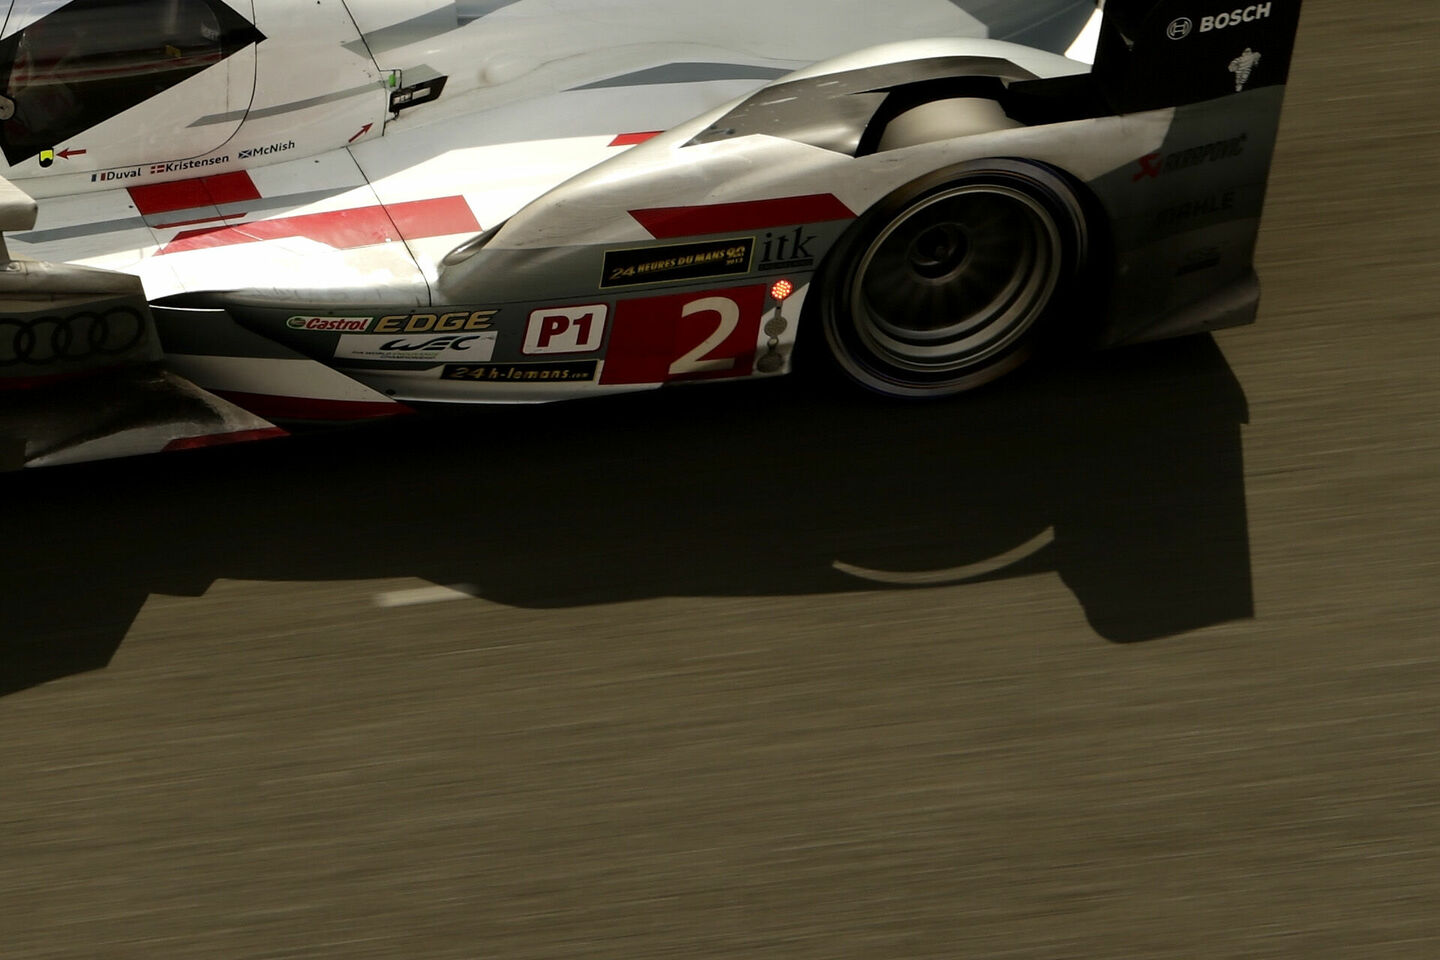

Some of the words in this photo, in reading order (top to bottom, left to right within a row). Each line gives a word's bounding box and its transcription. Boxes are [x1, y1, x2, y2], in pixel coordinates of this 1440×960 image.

[1199, 2, 1272, 33] BOSCH
[106, 167, 142, 181] Duval
[165, 154, 230, 173] Kristensen
[251, 140, 296, 157] McNish
[760, 227, 817, 263] itk
[609, 265, 636, 280] 24
[637, 257, 677, 273] HEURES
[677, 253, 695, 266] DU
[695, 248, 726, 263] MANS
[305, 317, 369, 331] Castrol
[372, 309, 498, 333] EDGE
[536, 312, 594, 348] P1
[668, 296, 740, 375] 2
[378, 335, 481, 351] WEC
